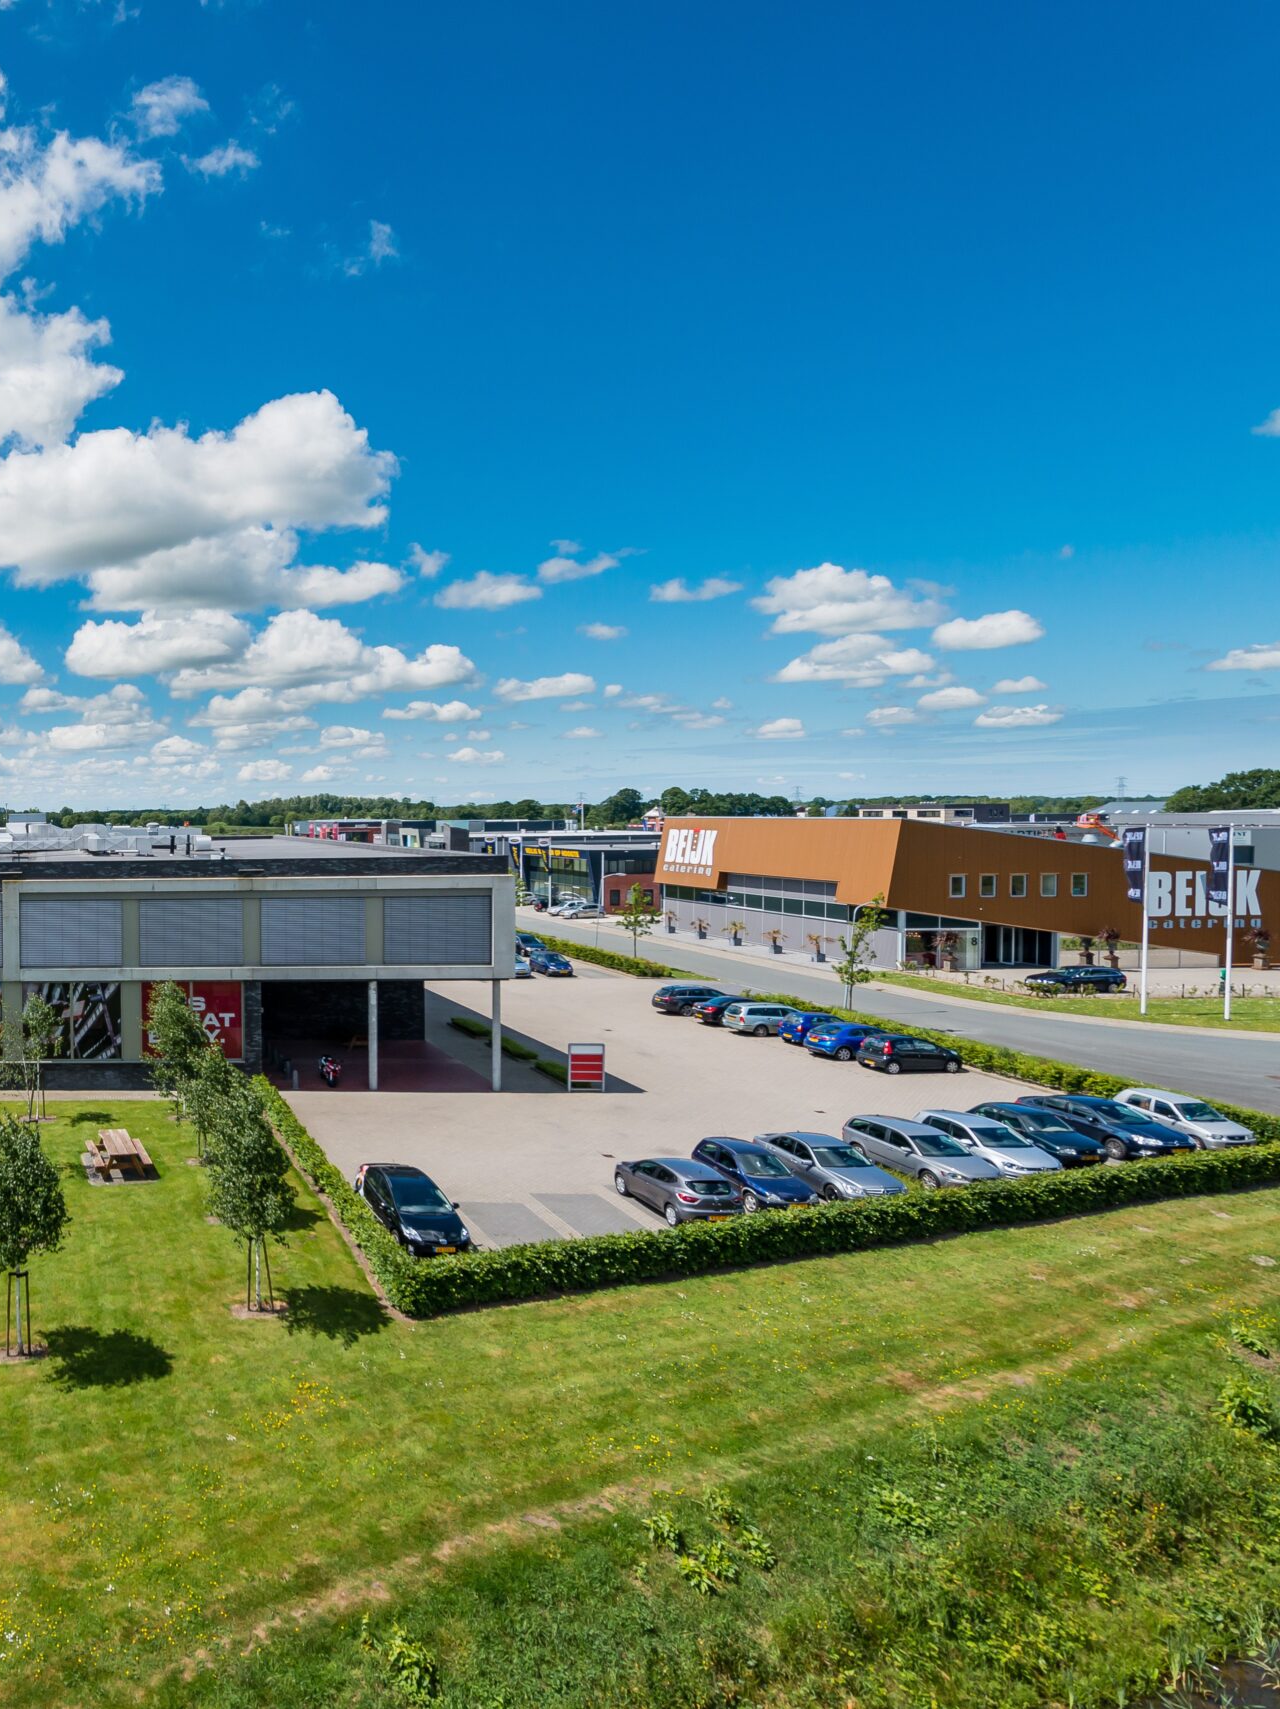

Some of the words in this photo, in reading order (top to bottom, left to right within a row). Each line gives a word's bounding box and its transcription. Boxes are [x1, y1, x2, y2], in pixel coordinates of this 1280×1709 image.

[664, 828, 718, 866] BEIJK
[663, 864, 712, 876] catering
[971, 937, 978, 946] 8
[148, 1029, 226, 1044] EY.
